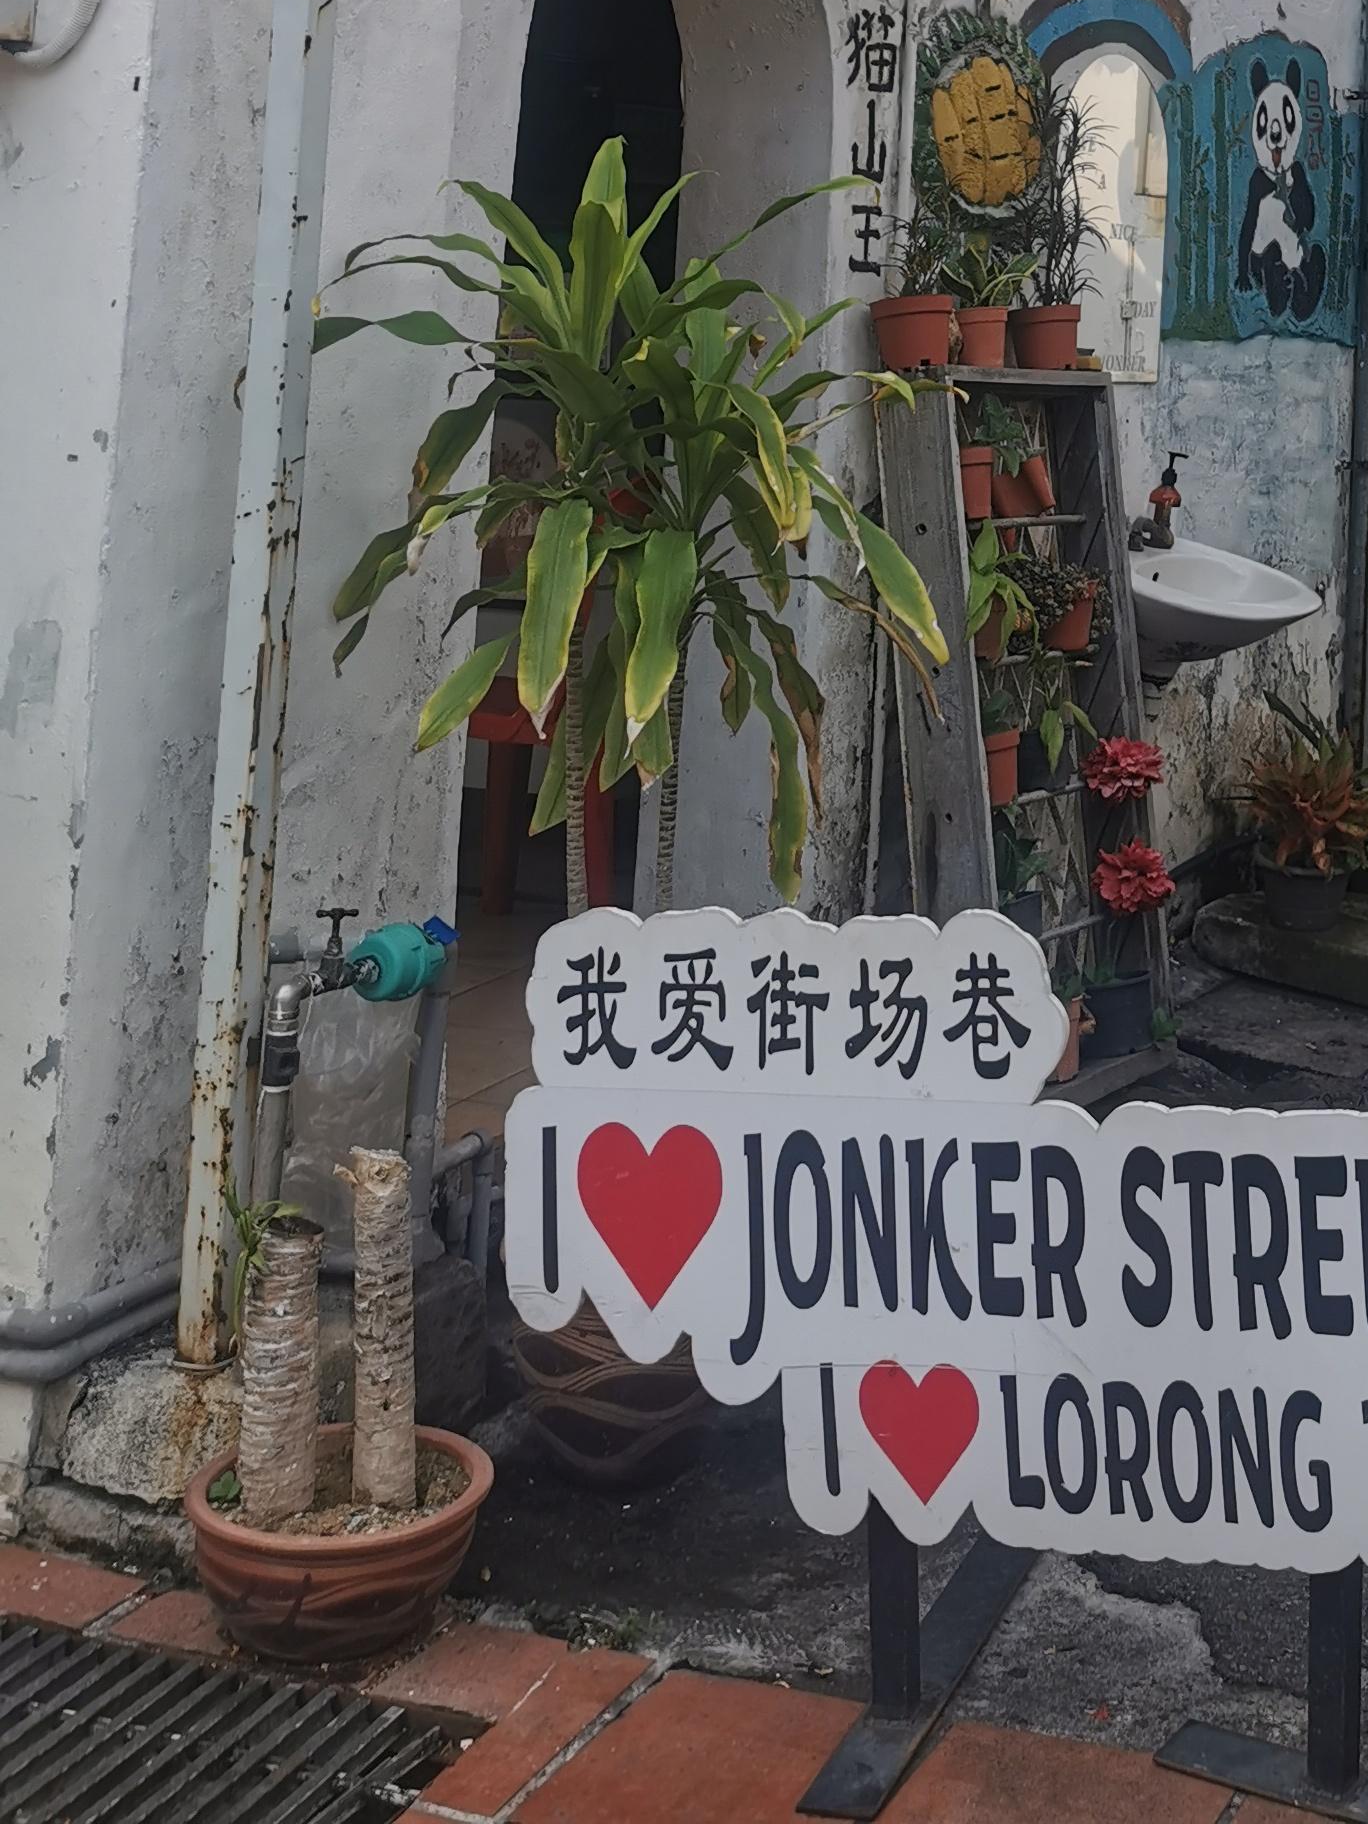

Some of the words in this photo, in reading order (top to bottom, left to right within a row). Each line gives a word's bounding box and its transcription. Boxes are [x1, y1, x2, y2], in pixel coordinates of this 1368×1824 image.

[845, 6, 898, 277] 猫山王
[556, 946, 1032, 1080] 我爱街场巷
[541, 1125, 560, 1295] I
[729, 1128, 1089, 1366] JONKER
[819, 1361, 841, 1497] I
[999, 1372, 1333, 1534] LORONG
